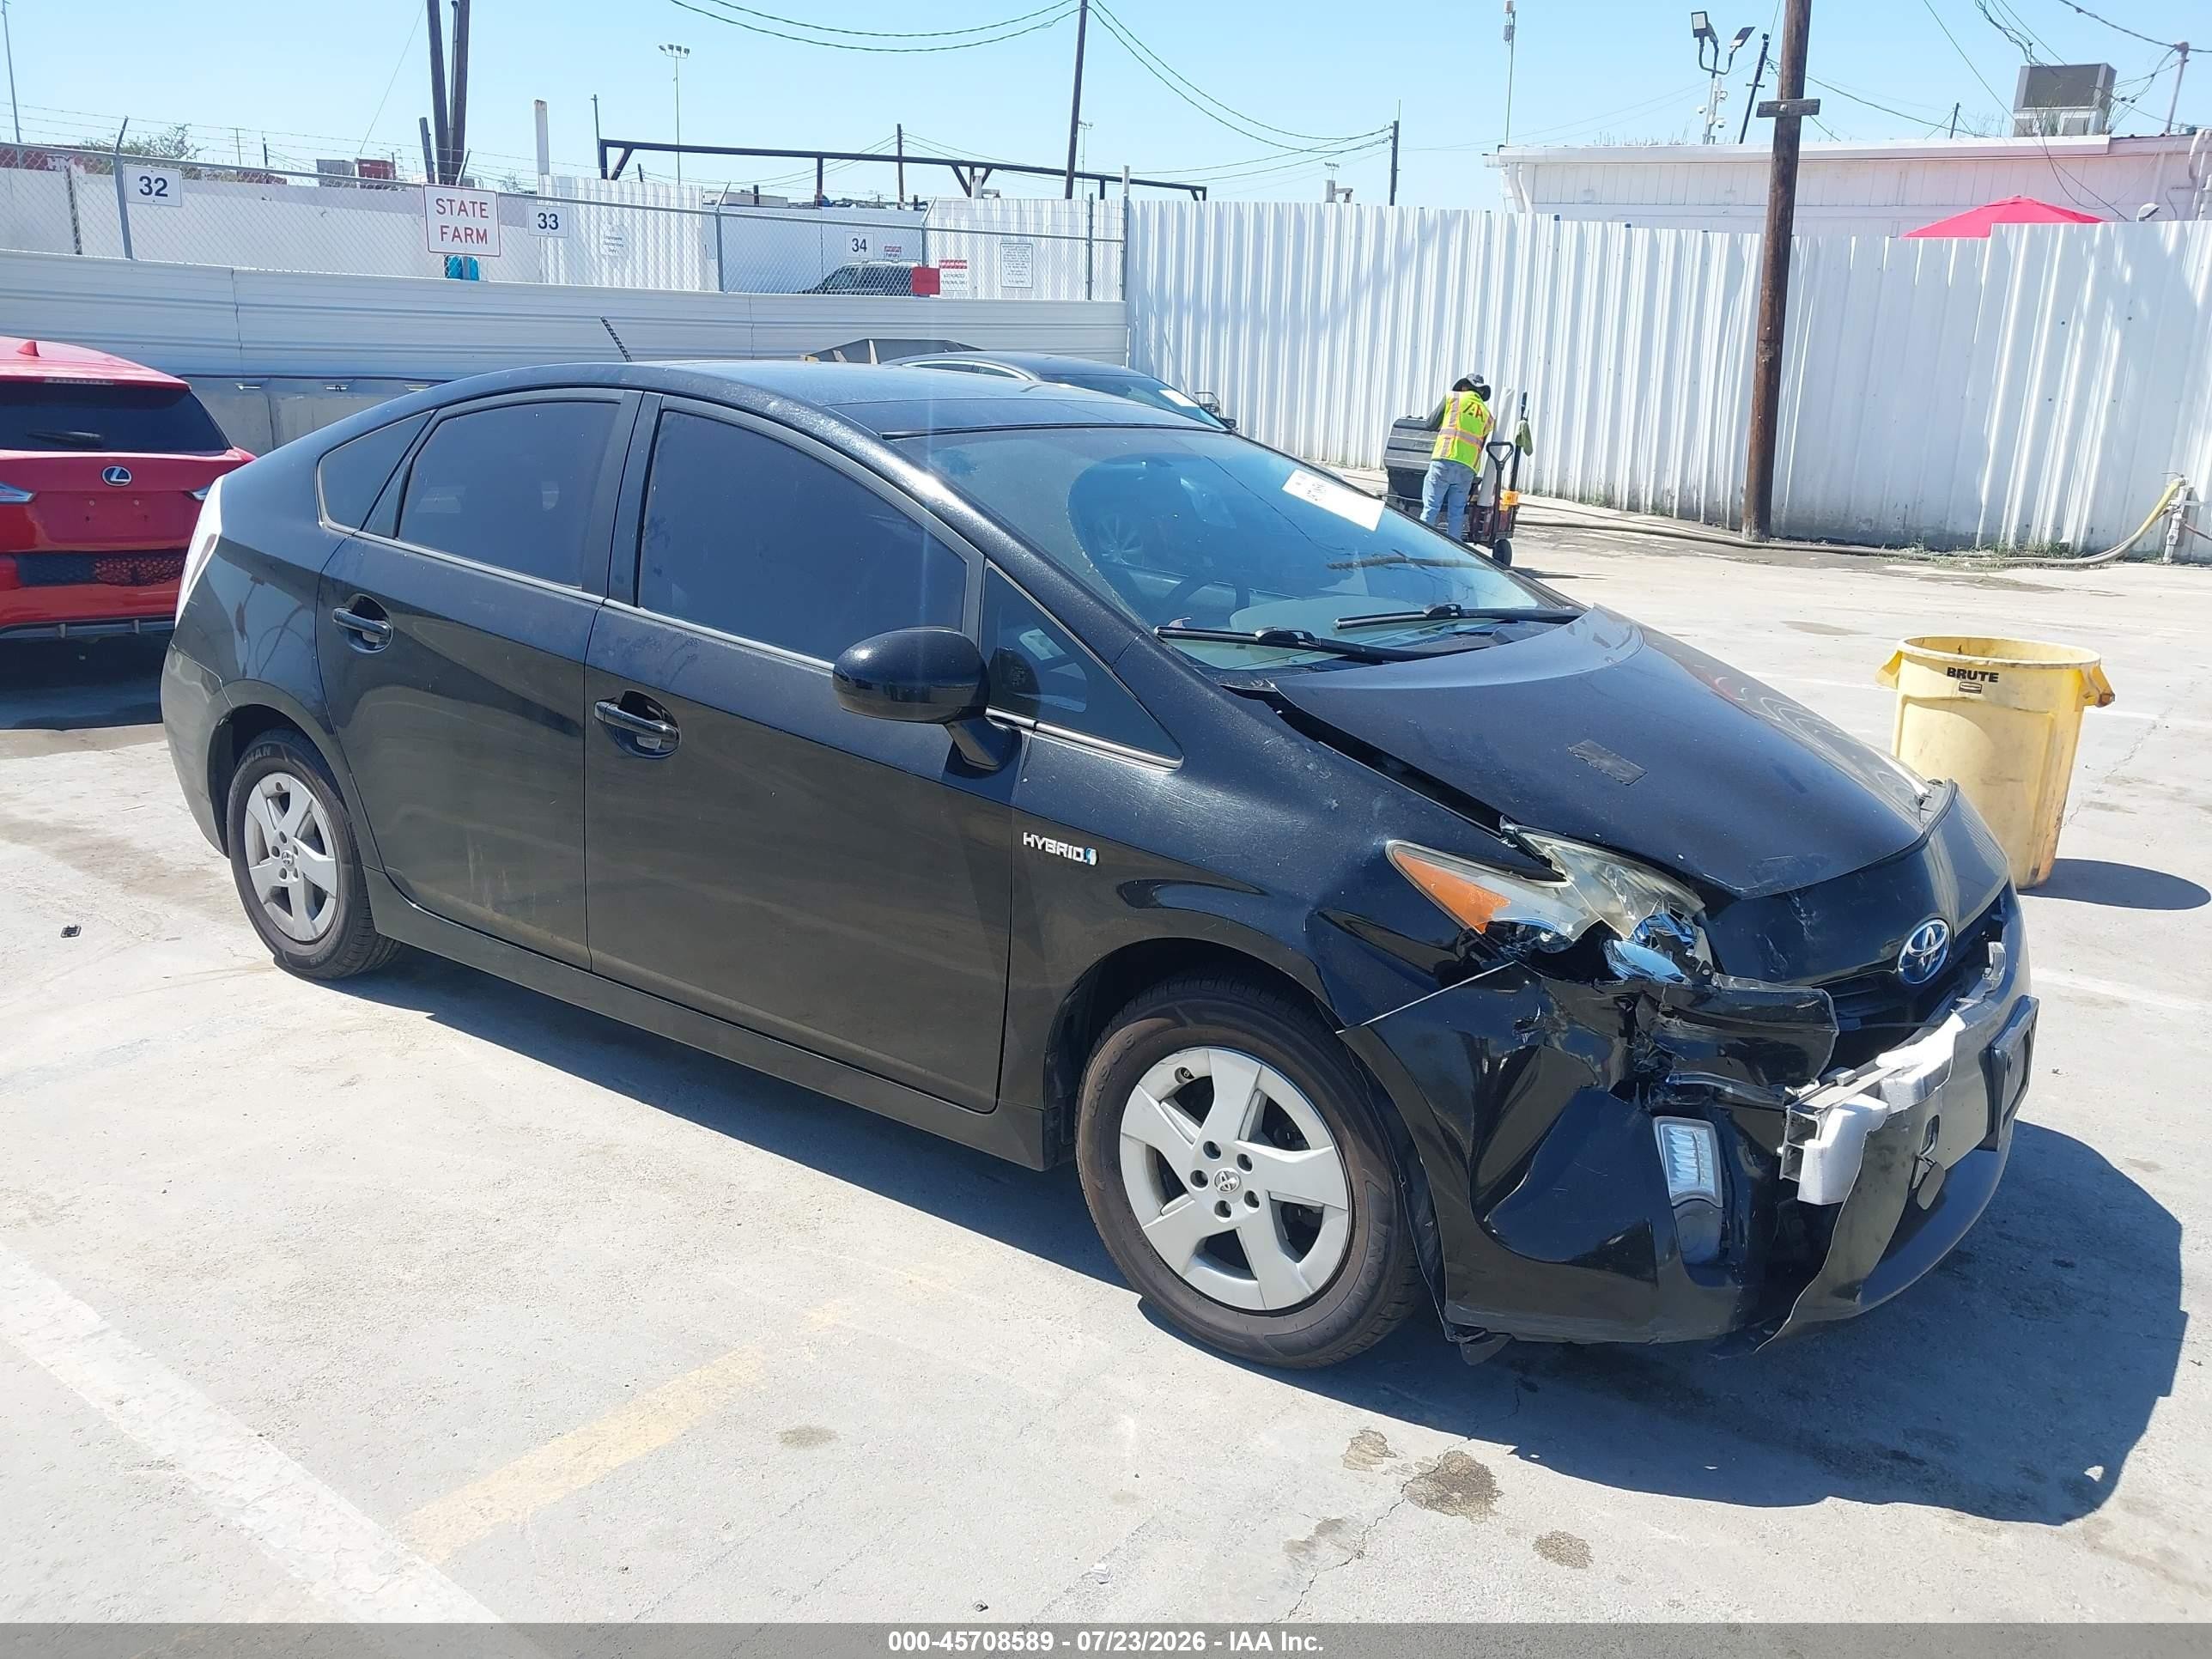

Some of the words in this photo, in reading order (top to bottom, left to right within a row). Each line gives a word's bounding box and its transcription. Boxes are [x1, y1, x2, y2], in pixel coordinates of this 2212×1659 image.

[138, 175, 168, 198] 32
[435, 198, 489, 219] STATE
[538, 212, 559, 230] 33
[440, 225, 489, 245] FARM
[851, 237, 867, 252] 34
[1946, 666, 2000, 684] BRUTE
[1023, 831, 1085, 863] HYBRID
